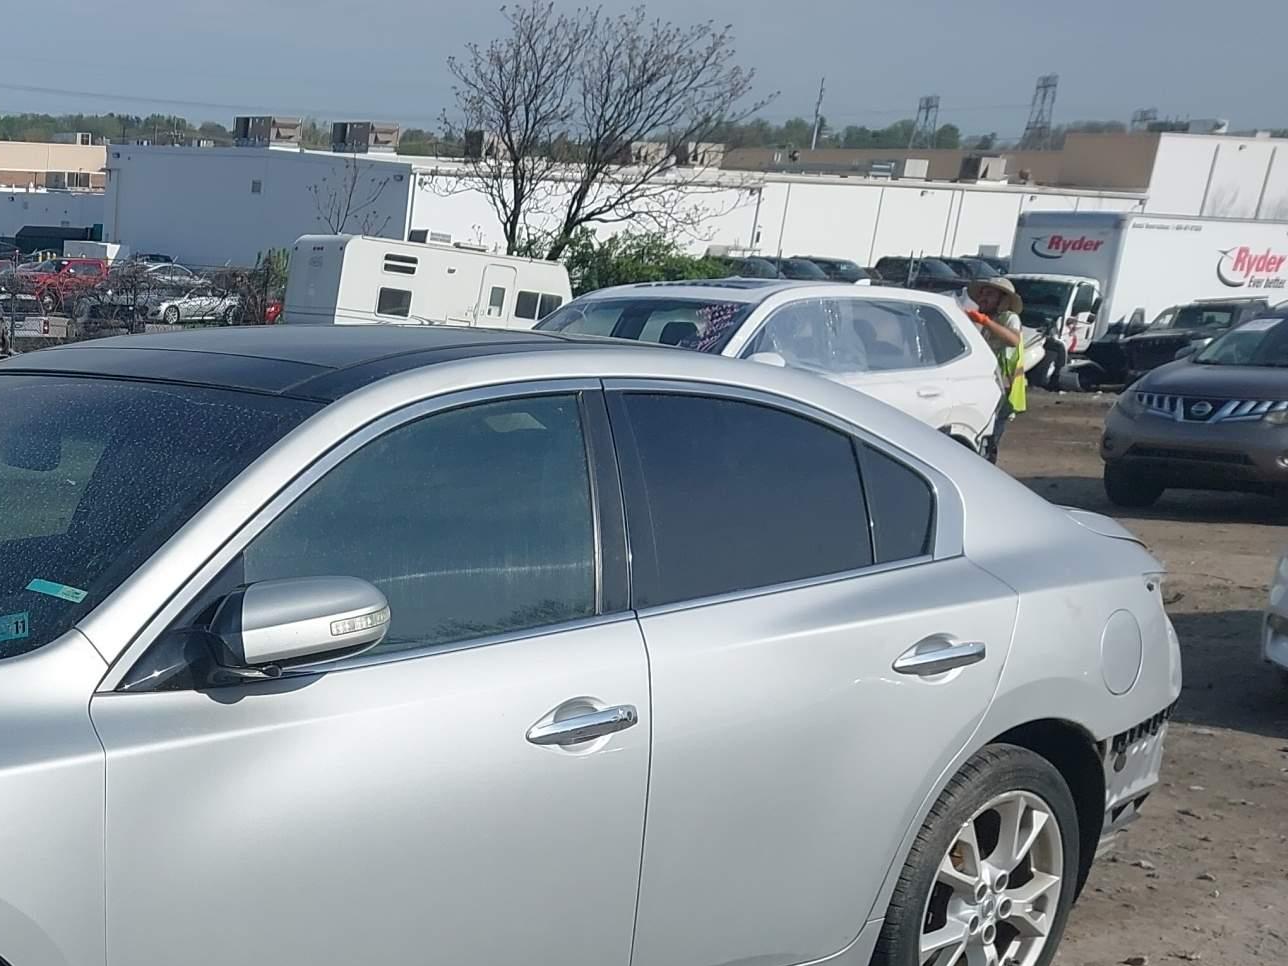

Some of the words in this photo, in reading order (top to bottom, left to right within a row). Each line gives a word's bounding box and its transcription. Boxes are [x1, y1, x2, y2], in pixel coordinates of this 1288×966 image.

[1048, 235, 1103, 253] Ryder
[1232, 246, 1286, 278] Ryder
[14, 620, 26, 635] 11
